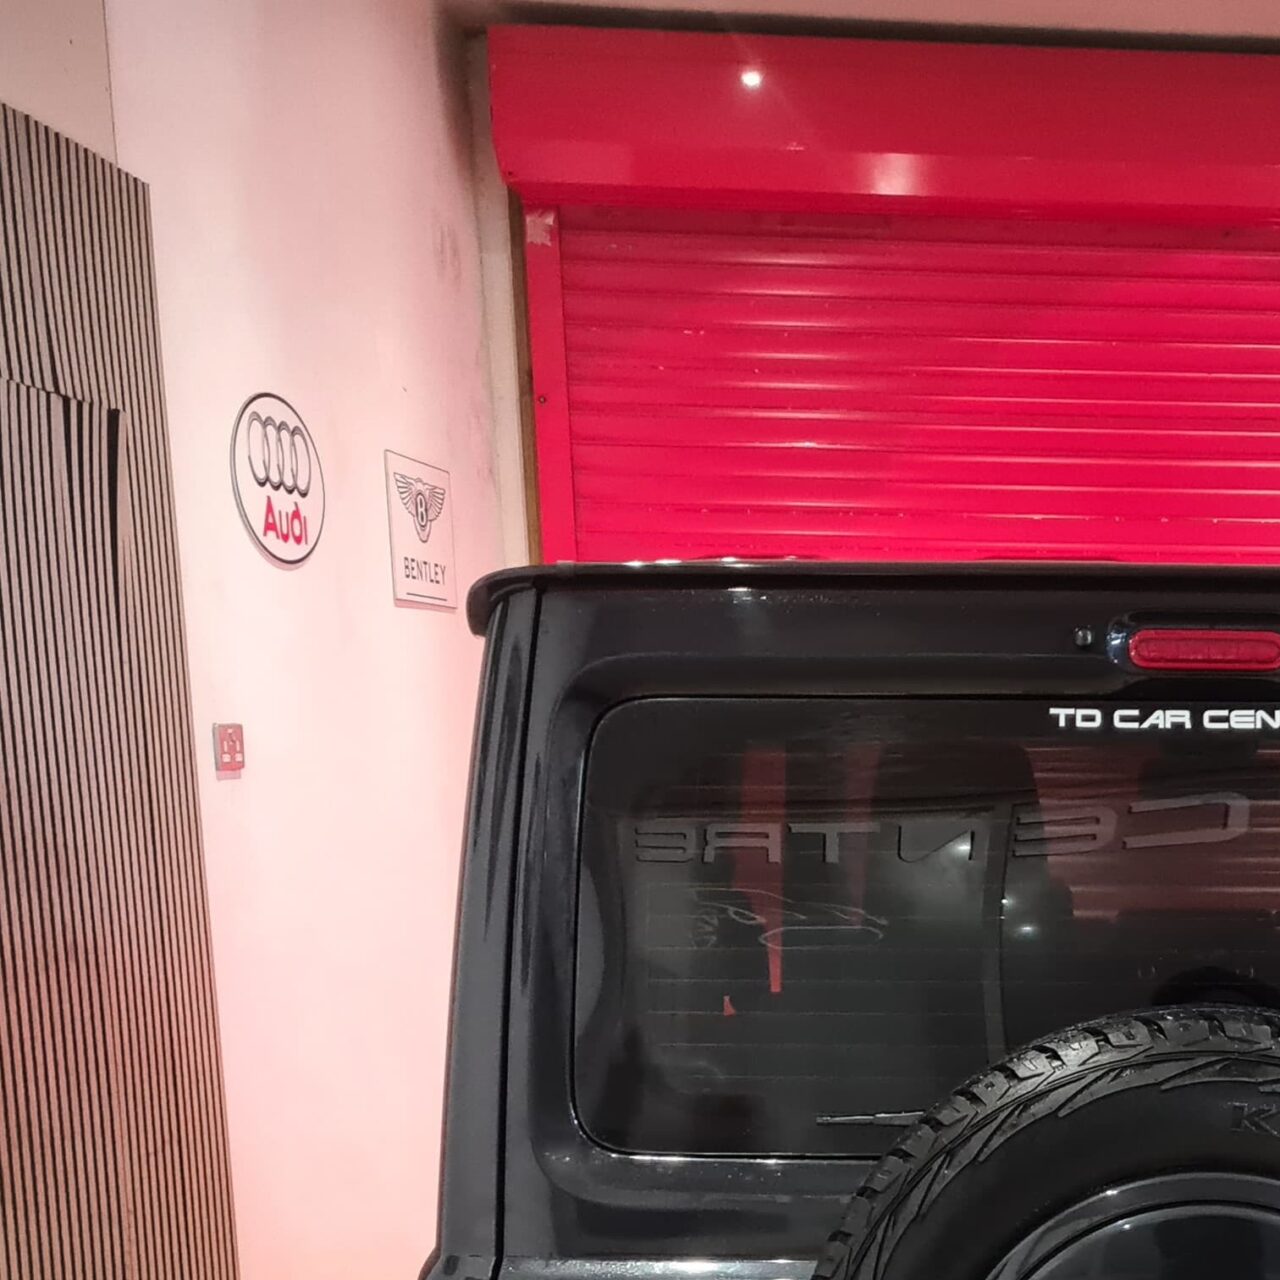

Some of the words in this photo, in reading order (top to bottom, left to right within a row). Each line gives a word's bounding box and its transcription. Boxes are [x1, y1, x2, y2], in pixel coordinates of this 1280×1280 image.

[263, 495, 308, 545] Audi
[404, 556, 446, 586] BENTLEY
[1049, 707, 1102, 728] TD
[1113, 708, 1192, 729] CAR
